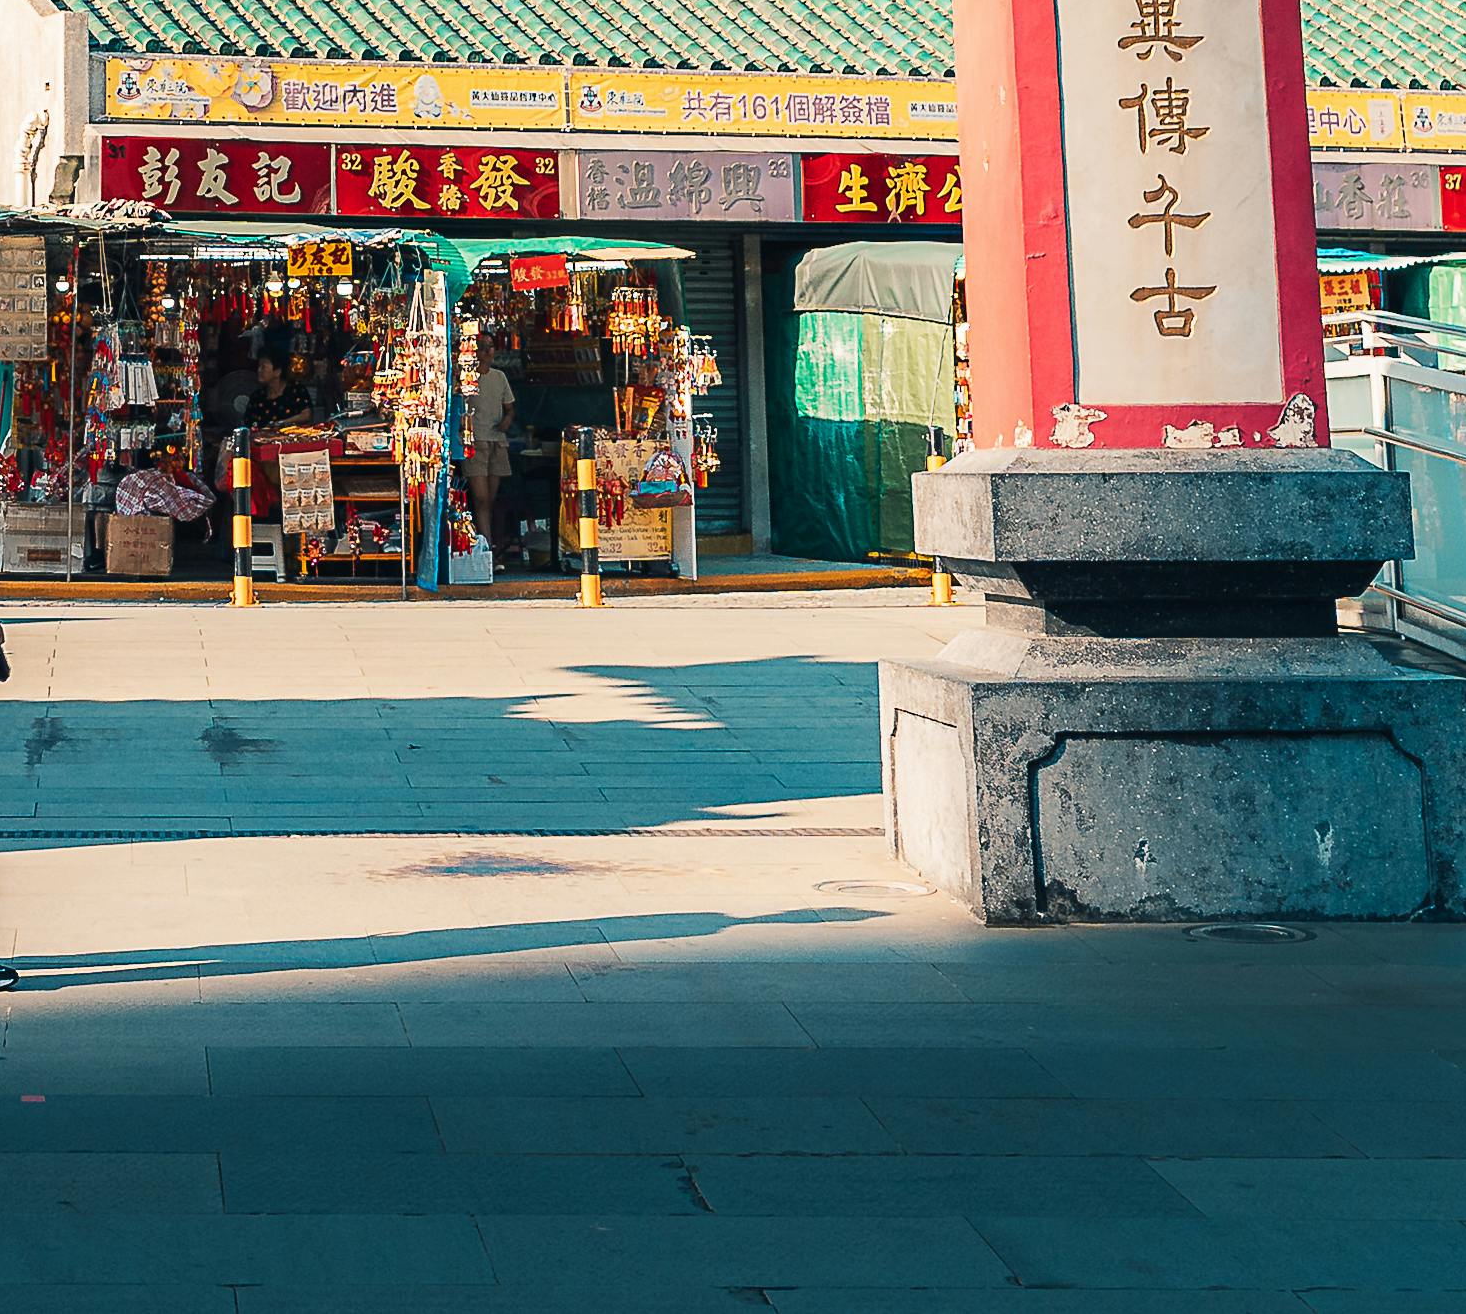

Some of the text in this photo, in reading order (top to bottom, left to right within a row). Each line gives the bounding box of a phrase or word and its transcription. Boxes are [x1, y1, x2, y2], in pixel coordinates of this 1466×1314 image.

[341, 152, 363, 172] 32
[535, 157, 556, 175] 32
[137, 145, 302, 206] 彭友記
[1445, 173, 1462, 191] 37
